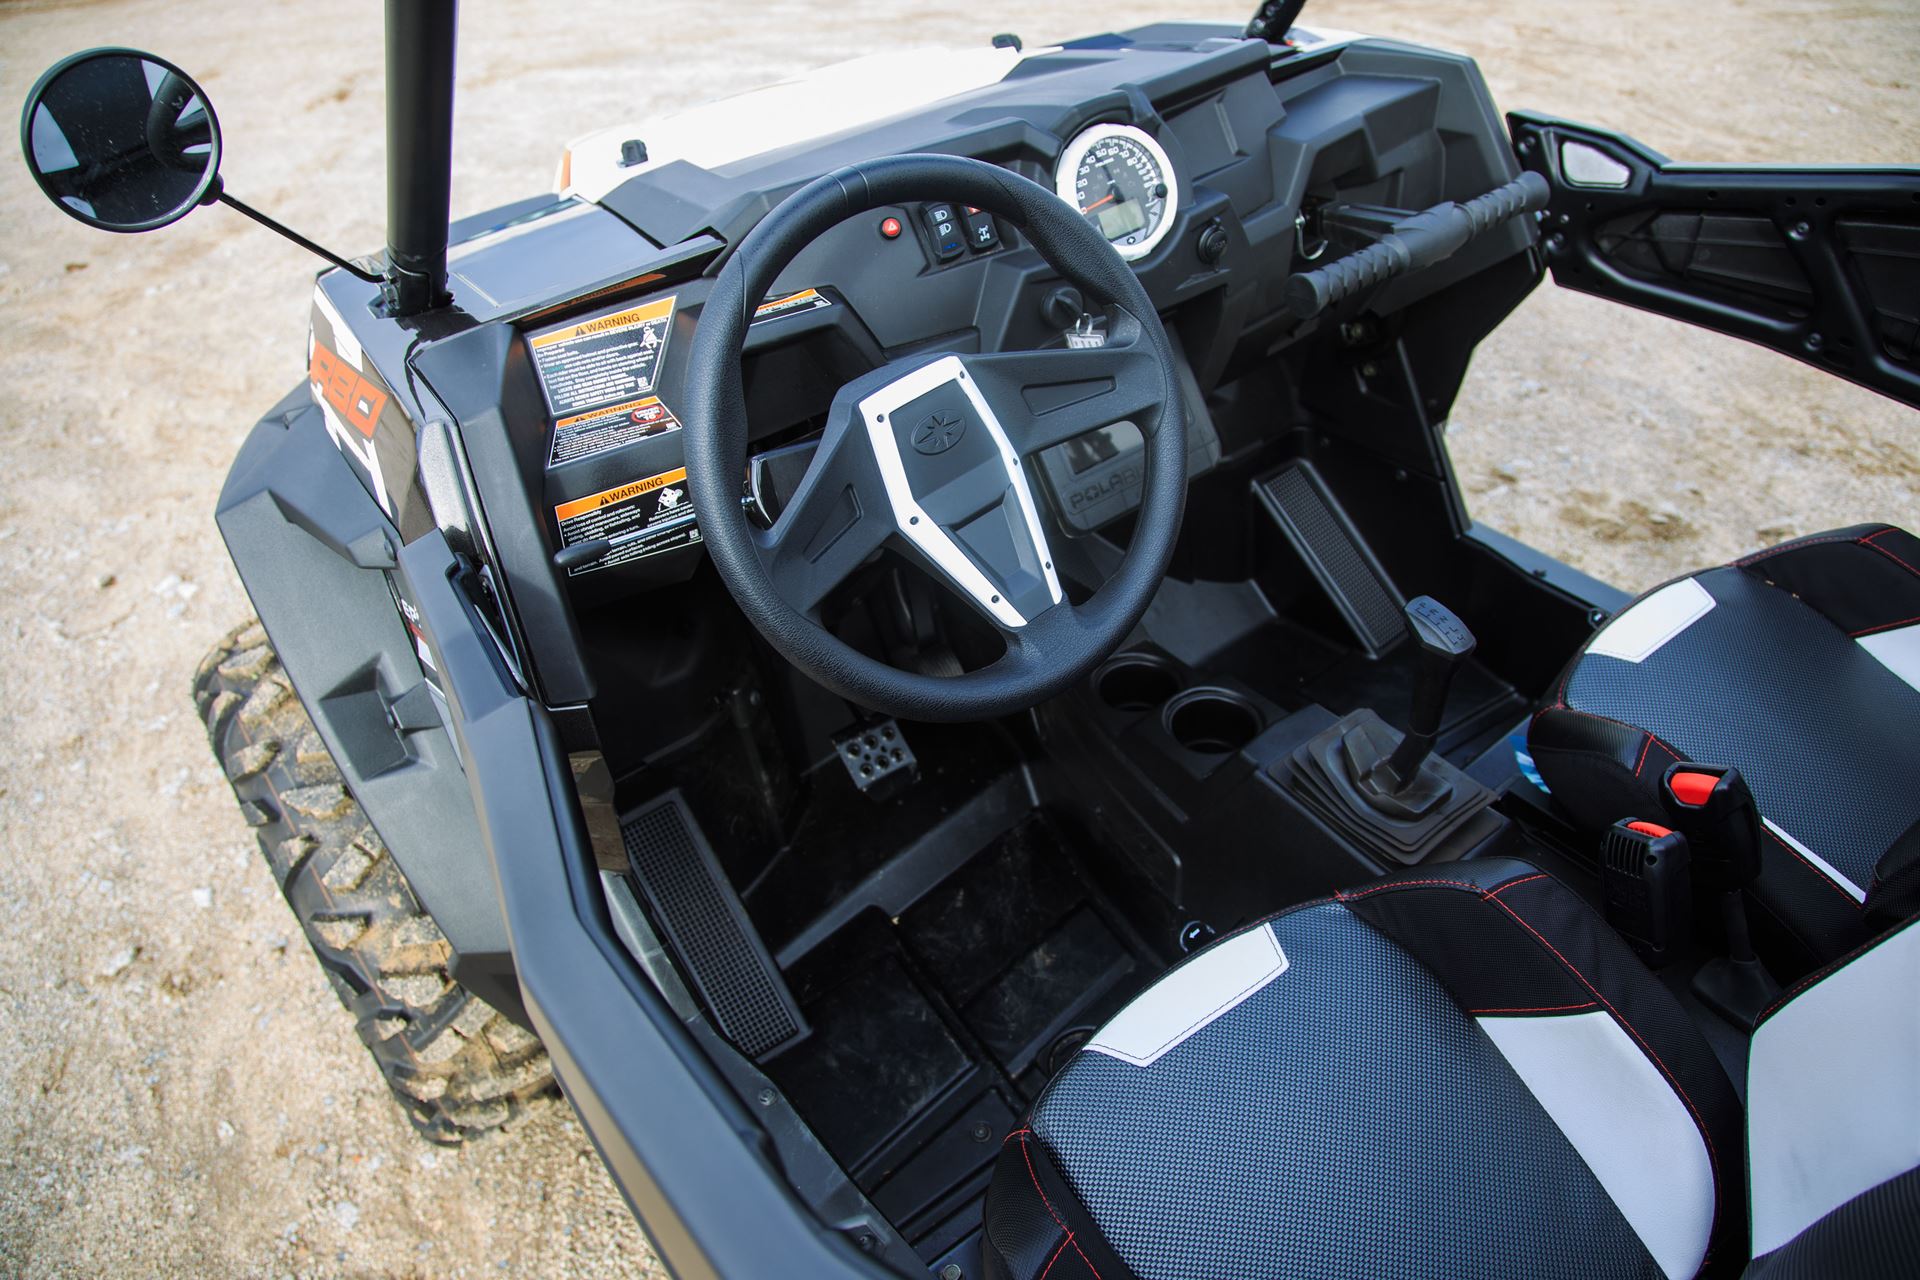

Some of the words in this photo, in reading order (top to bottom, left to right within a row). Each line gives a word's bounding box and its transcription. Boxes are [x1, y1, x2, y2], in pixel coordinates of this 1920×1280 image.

[1095, 148, 1107, 158] 50
[1107, 146, 1119, 156] 60
[586, 313, 640, 332] WARNING
[588, 402, 641, 418] WARNING
[609, 477, 664, 502] WARNING
